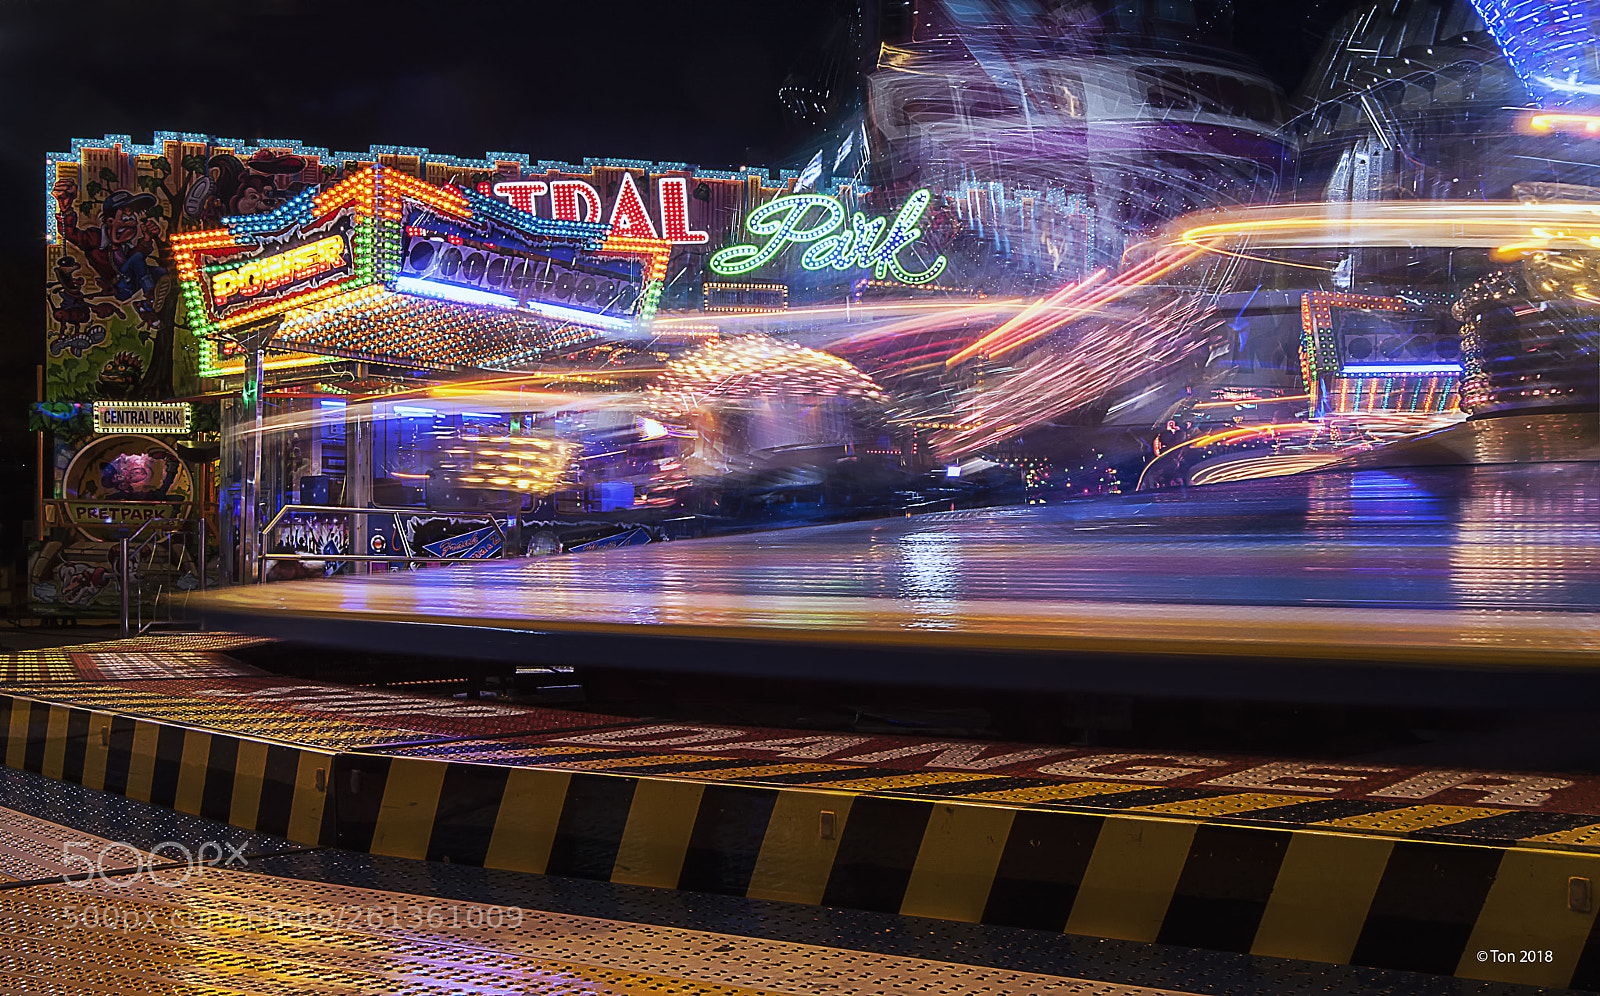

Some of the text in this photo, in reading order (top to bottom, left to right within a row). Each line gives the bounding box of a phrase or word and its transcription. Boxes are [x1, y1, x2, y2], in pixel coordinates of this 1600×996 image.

[710, 189, 947, 284] Park
[103, 410, 181, 425] CENTRAL PARK
[76, 507, 167, 520] PRETPARK
[546, 723, 1575, 807] DANGER
